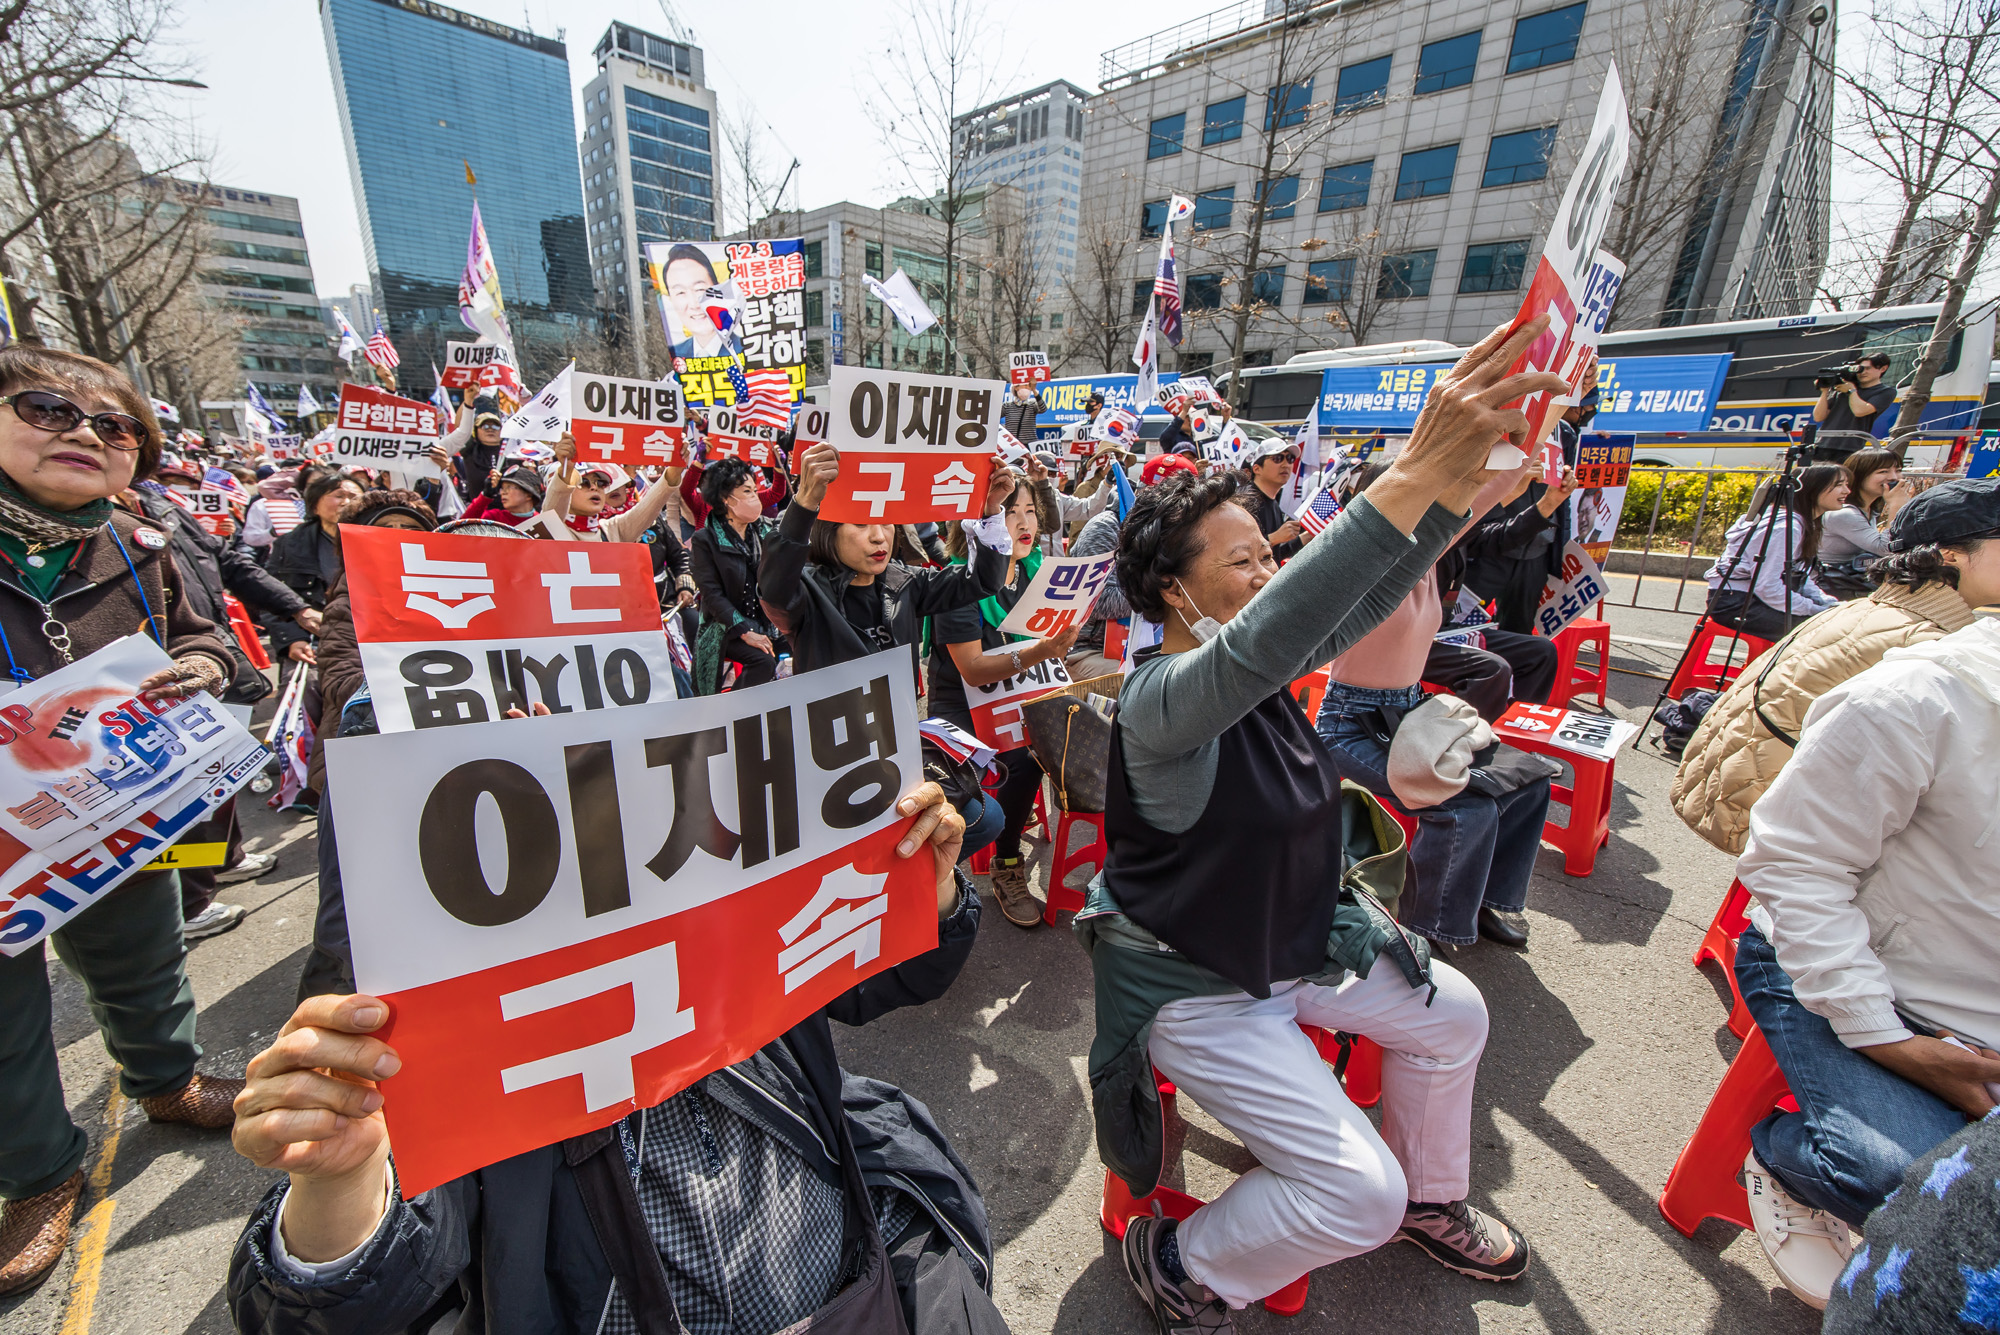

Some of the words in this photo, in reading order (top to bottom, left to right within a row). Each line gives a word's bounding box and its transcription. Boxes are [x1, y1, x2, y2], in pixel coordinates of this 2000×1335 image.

[728, 243, 770, 260] 12.3
[731, 254, 804, 279] 계몽령은
[737, 272, 806, 298] 정당하다
[741, 291, 805, 337] 탄핵
[454, 346, 494, 365] 이재명
[743, 330, 807, 367] 각하!
[1013, 354, 1046, 367] 이재명
[680, 363, 806, 407] 직무귀
[1377, 369, 1427, 392] 지금은
[584, 380, 678, 423] 이재명
[1042, 384, 1092, 412] 이재명
[1322, 393, 1396, 412] 반국가세력으로
[1397, 393, 1421, 412] 부터
[1598, 390, 1633, 413] 님을
[1635, 389, 1707, 413] 지킵시다.
[342, 400, 437, 435] 탄핵무효
[849, 380, 992, 448] 이재명
[1708, 413, 1811, 432] POLICE
[337, 435, 401, 459] 이재명
[1580, 446, 1609, 465] 민주당
[1610, 446, 1632, 464] 해체!
[1592, 490, 1613, 527] OUT!
[1540, 575, 1601, 637] 민주당
[48, 706, 90, 741] THE
[418, 675, 902, 927] 이재명
[0, 797, 211, 945] STEAL
[1752, 1174, 1764, 1196] FILA
